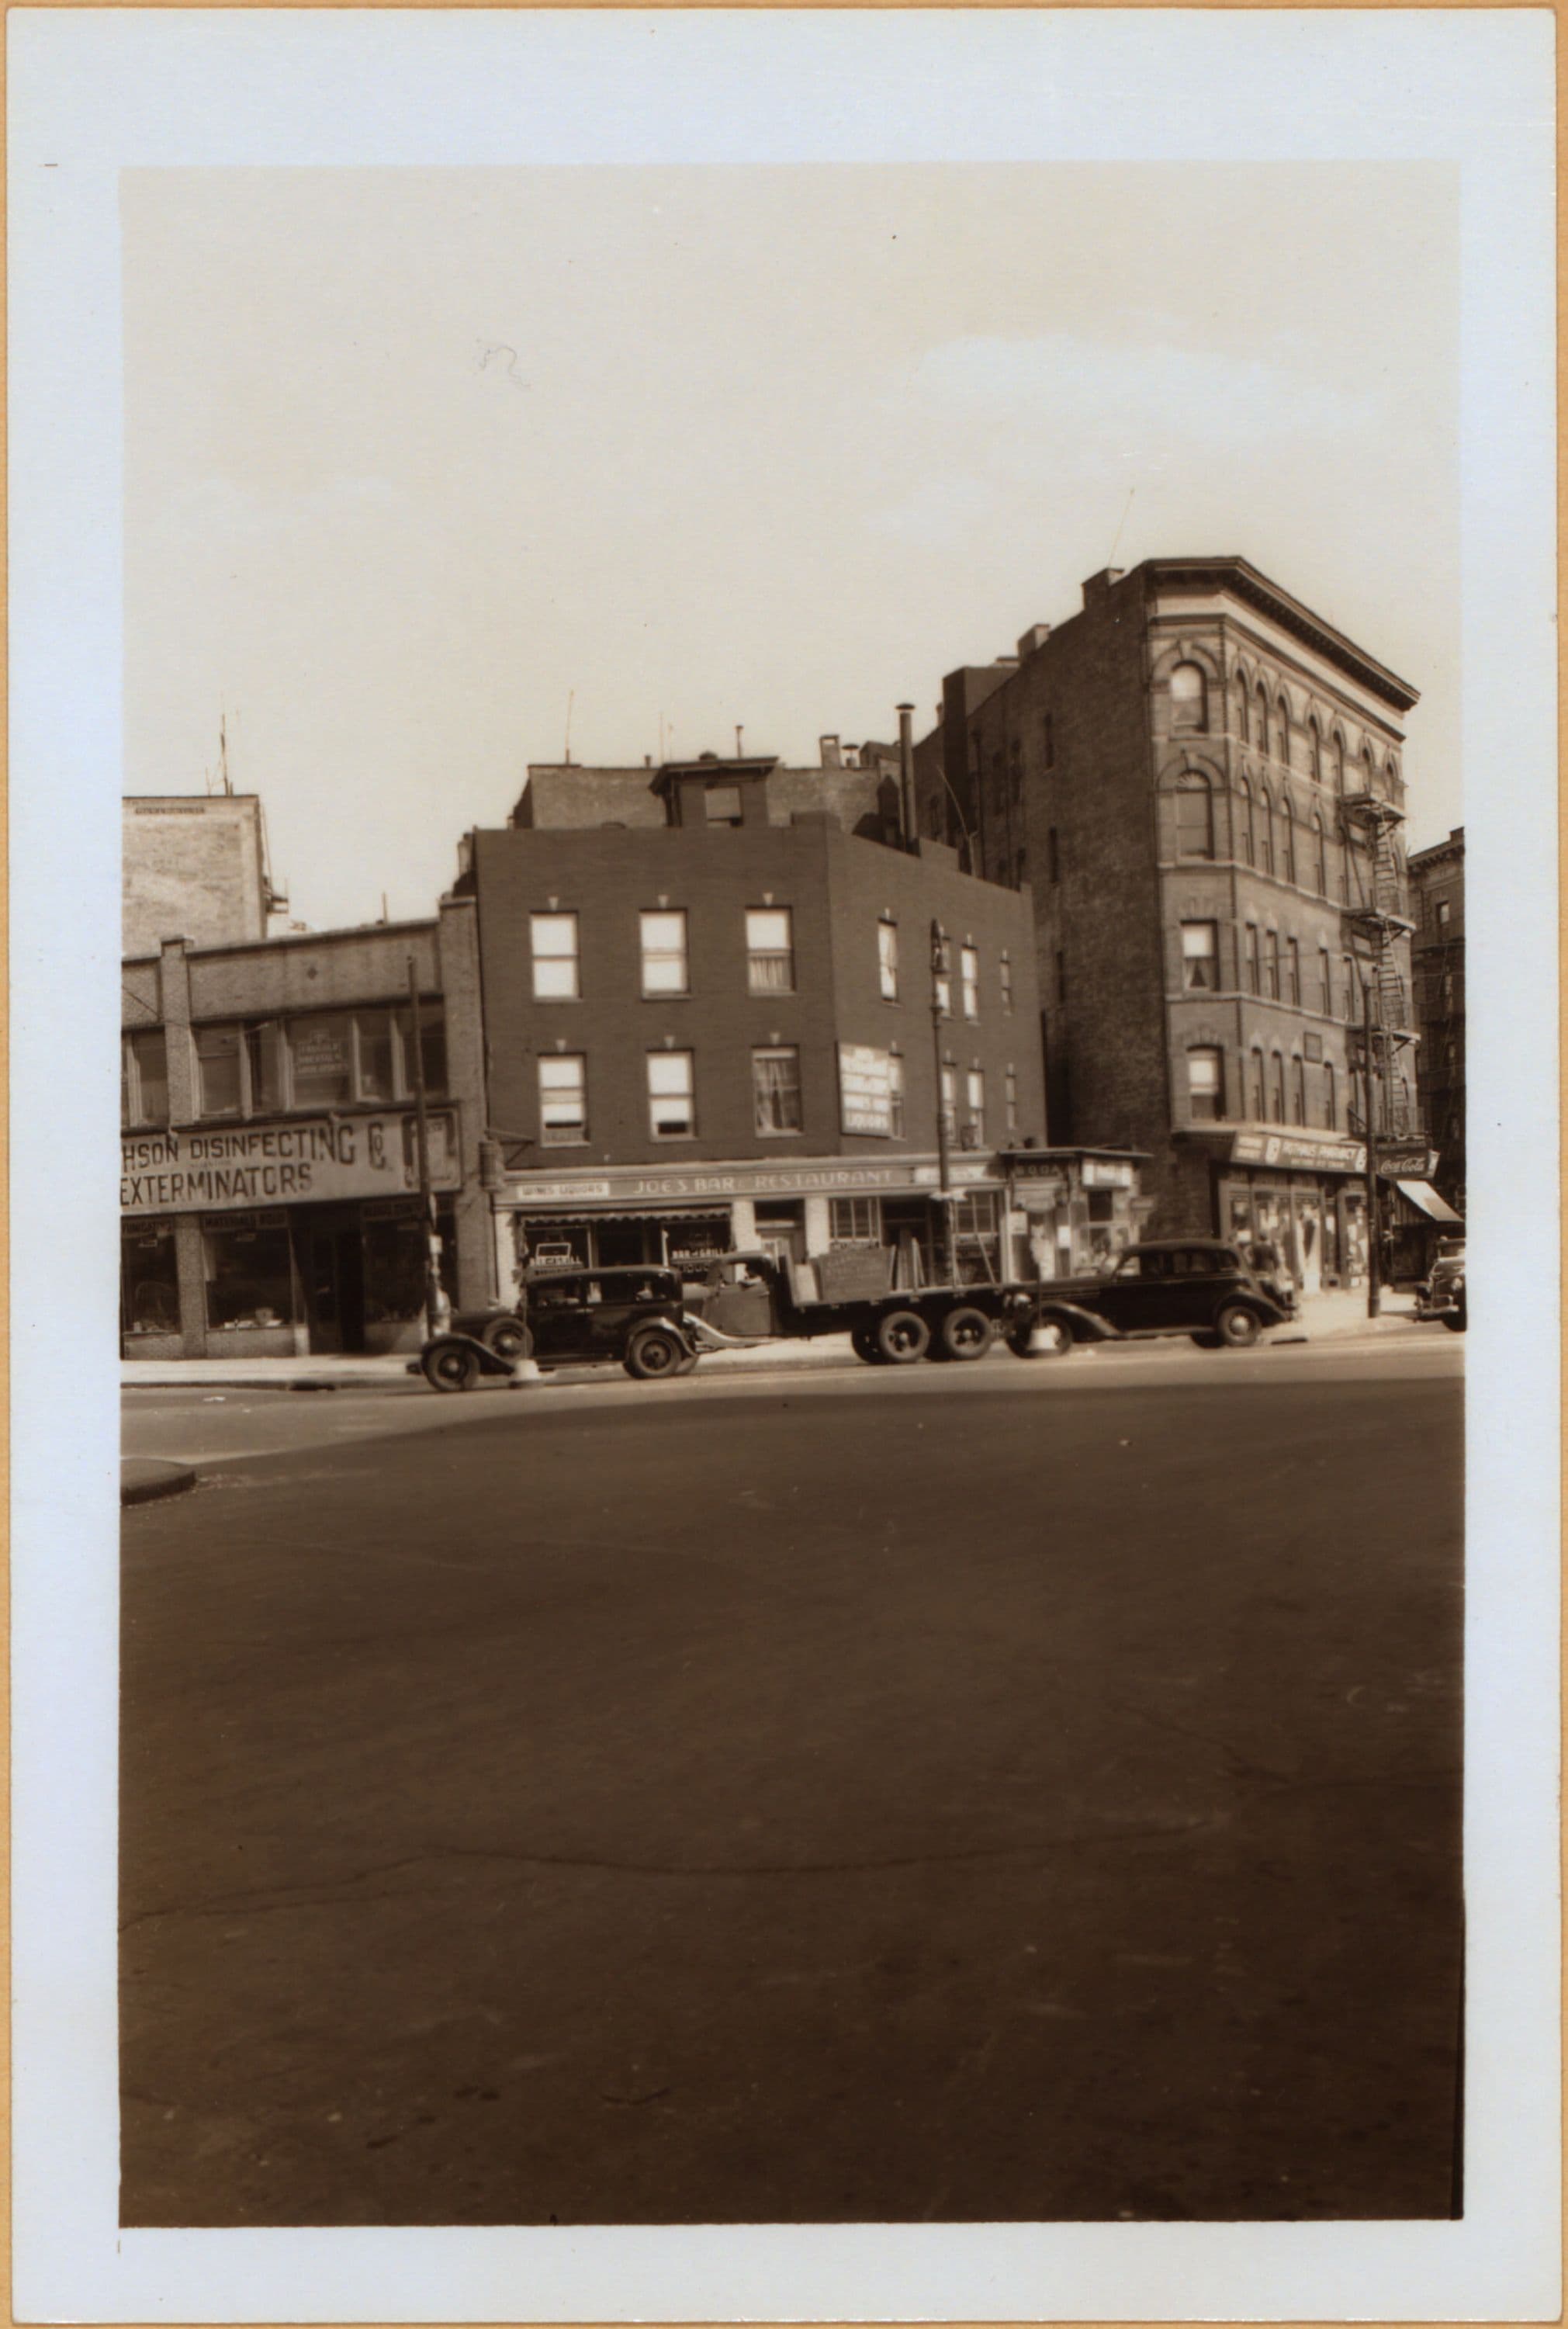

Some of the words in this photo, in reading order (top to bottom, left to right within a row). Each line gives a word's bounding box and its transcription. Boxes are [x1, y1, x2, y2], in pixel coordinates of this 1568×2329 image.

[190, 1123, 355, 1166] DISINFECTING
[121, 1163, 312, 1207] EXTERMINATORS
[694, 1176, 735, 1192] BAR
[756, 1170, 892, 1189] RESTAURANT
